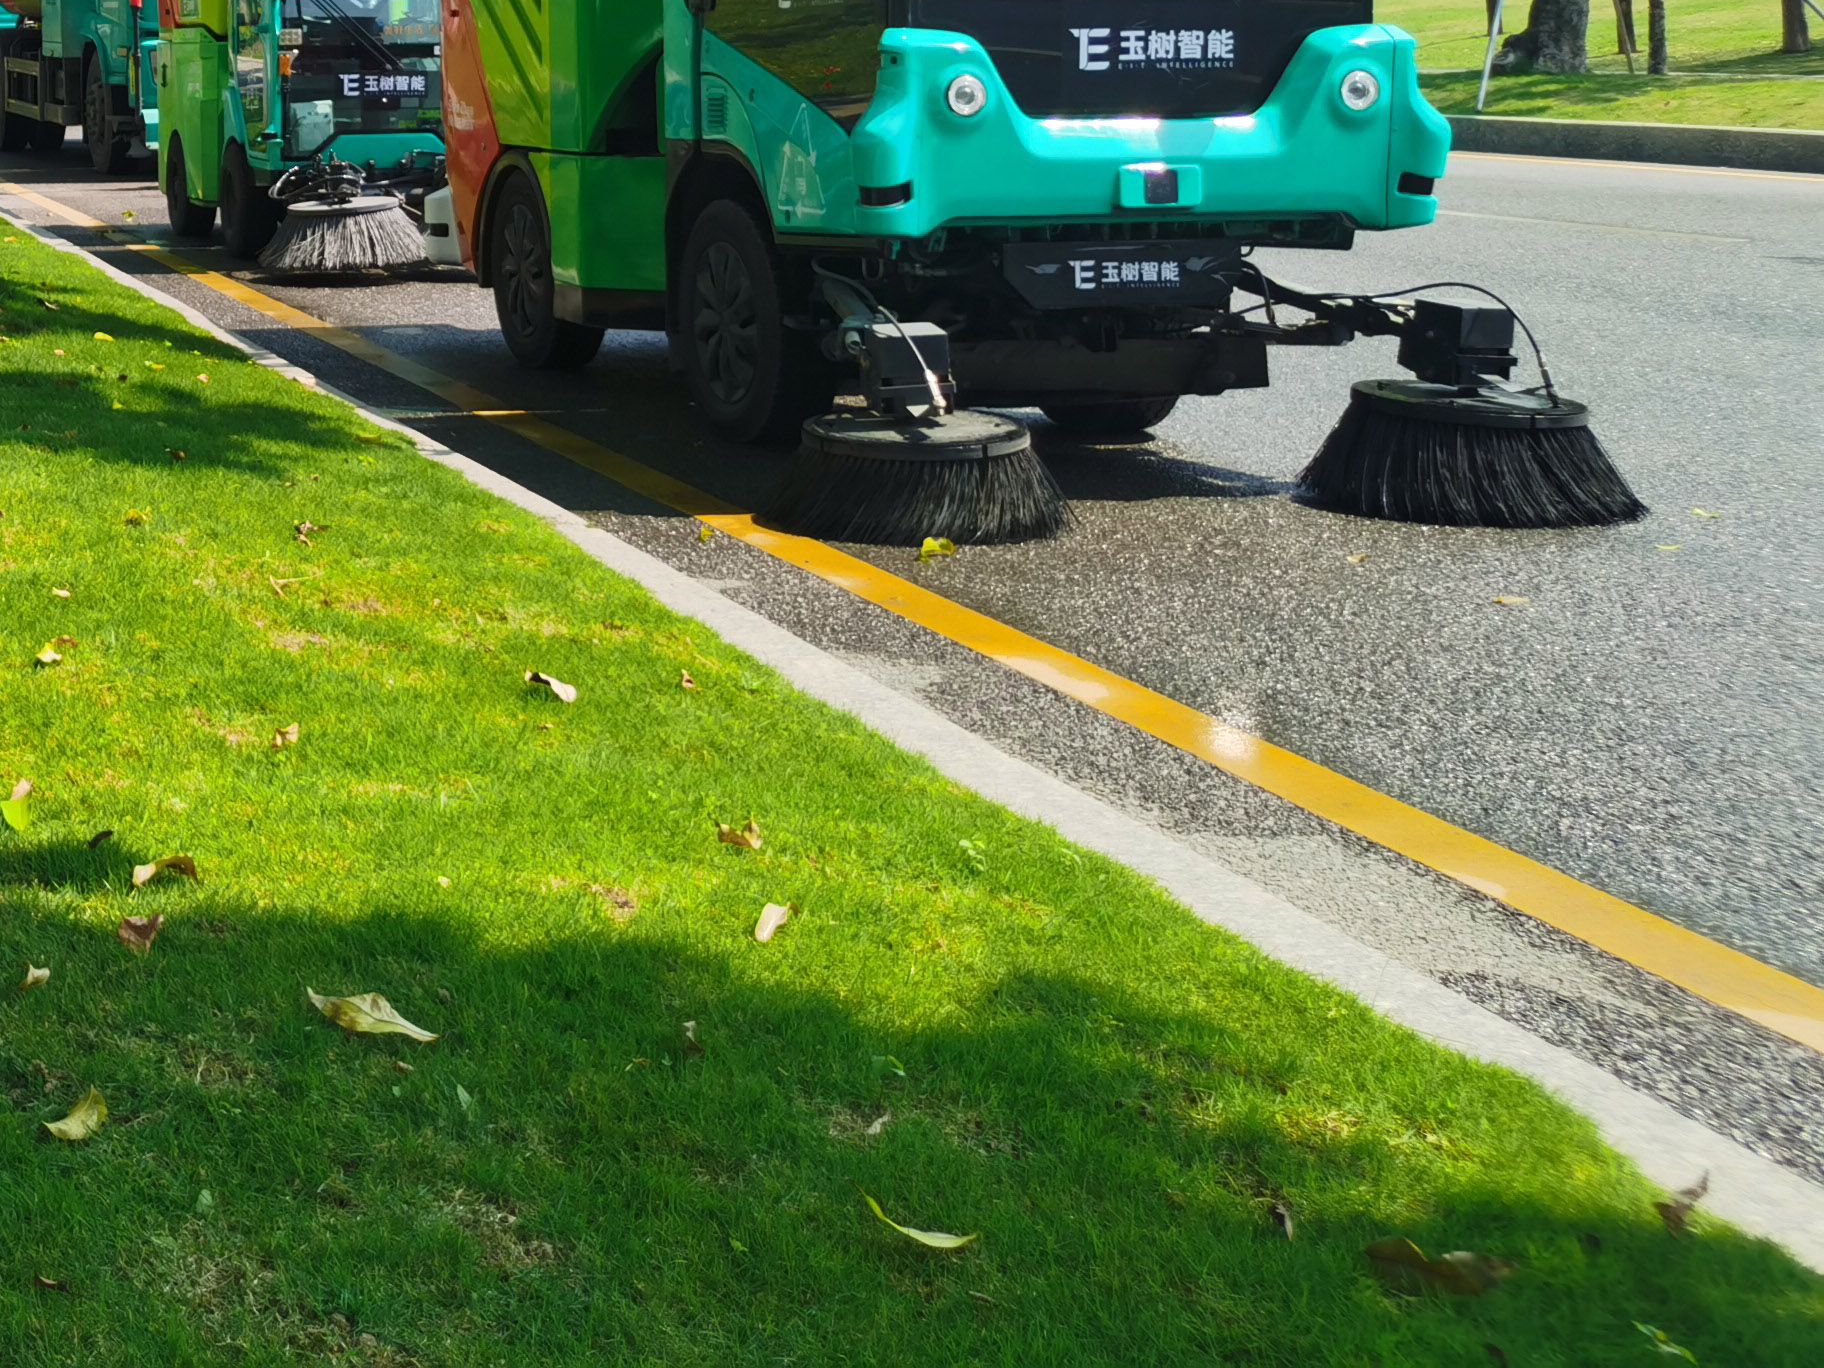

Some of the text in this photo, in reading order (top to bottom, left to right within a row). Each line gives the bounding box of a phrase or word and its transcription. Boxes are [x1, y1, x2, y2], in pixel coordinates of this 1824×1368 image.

[1118, 28, 1235, 61] 玉树智能
[1156, 61, 1234, 69] INTELLIGENCE
[363, 75, 426, 92] 玉树智能
[1101, 261, 1181, 283] 玉树智能
